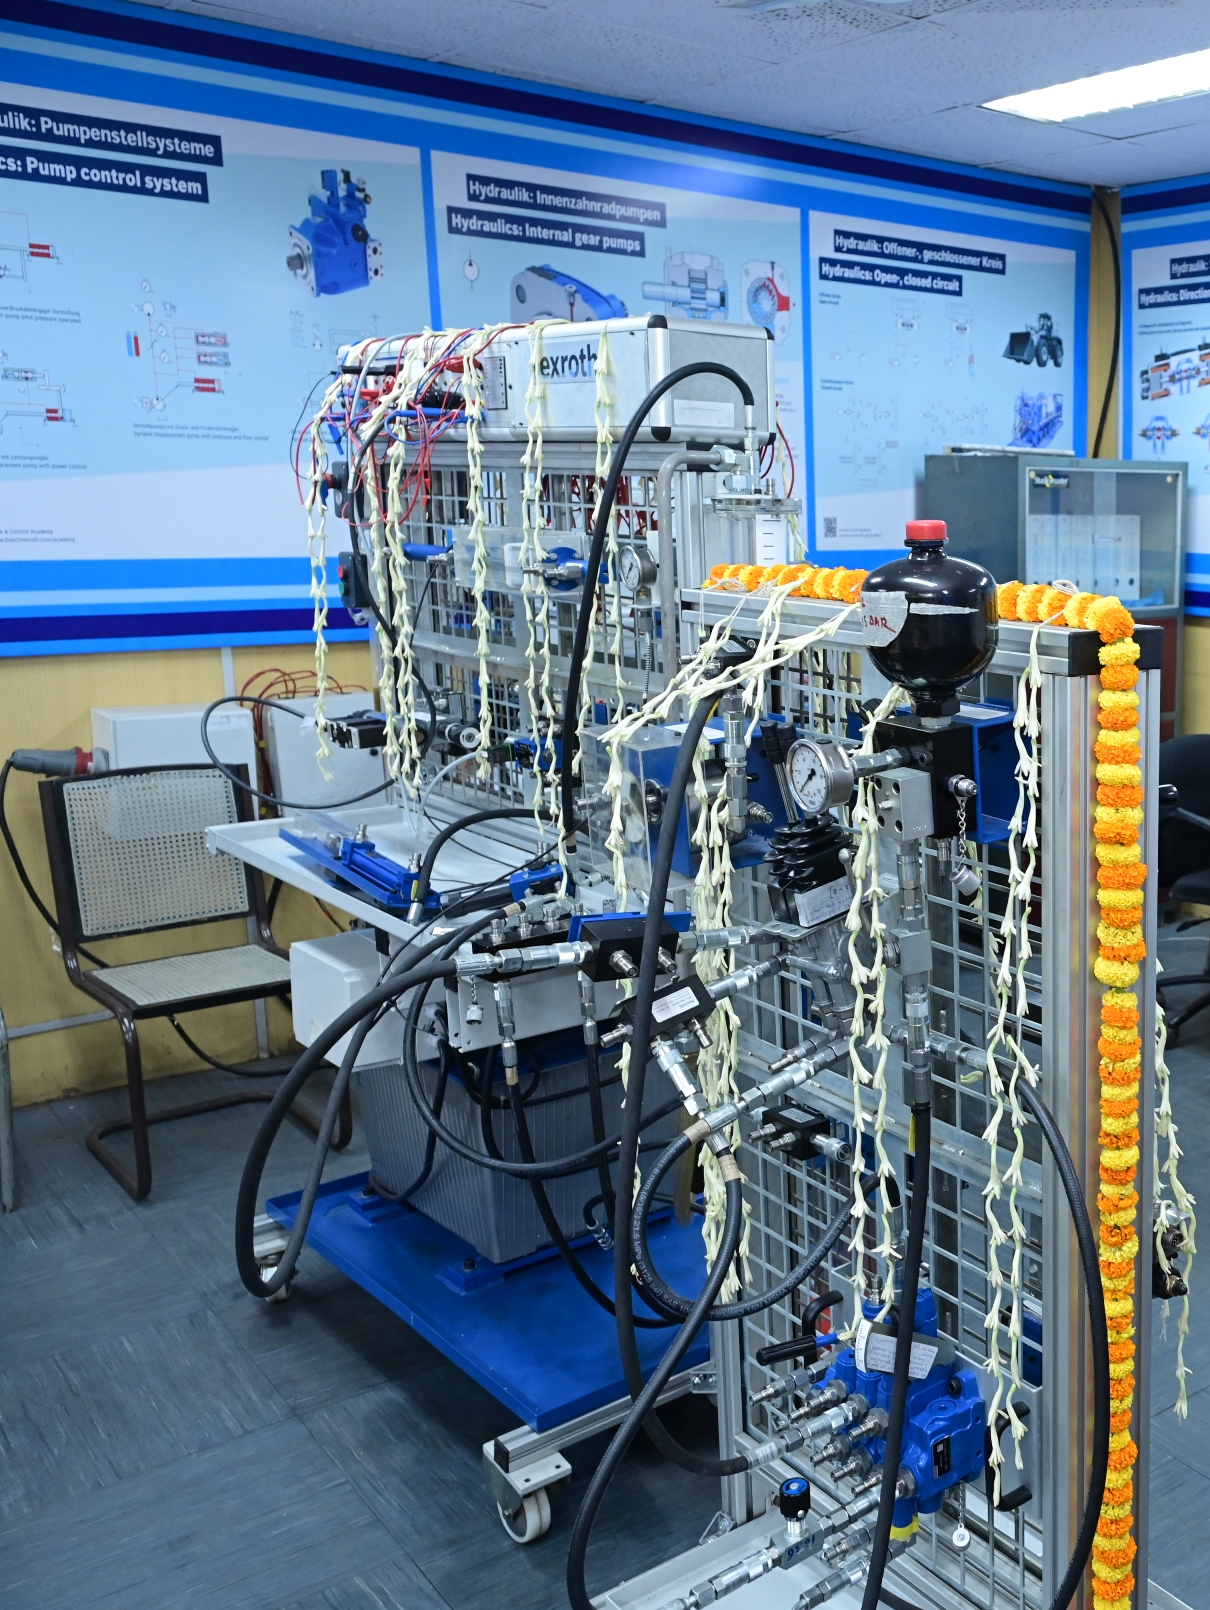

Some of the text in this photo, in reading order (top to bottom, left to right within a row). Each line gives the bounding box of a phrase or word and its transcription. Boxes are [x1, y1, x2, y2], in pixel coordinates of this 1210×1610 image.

[40, 116, 215, 158] Pumpenstellsysteme
[26, 156, 76, 182] Pump
[81, 167, 141, 188] control
[145, 174, 203, 196] system
[469, 179, 660, 223] Hydraulik: Innenzahnradpumpen
[451, 213, 640, 252] Hydraulics: Internal gear pumps
[835, 234, 1003, 270] Hydraulik: Offener-, geschlossener Kreis
[822, 263, 960, 292] Hydraulics: Open-, closed circuit
[1171, 259, 1208, 277] Hydraulik:
[1140, 291, 1179, 307] Hydraulics:
[540, 343, 598, 380] exroth
[869, 614, 896, 634] BAR
[643, 1173, 655, 1191] mm
[633, 1238, 644, 1261] MPa
[637, 1261, 653, 1284] (3125
[661, 1294, 678, 1310] SAE
